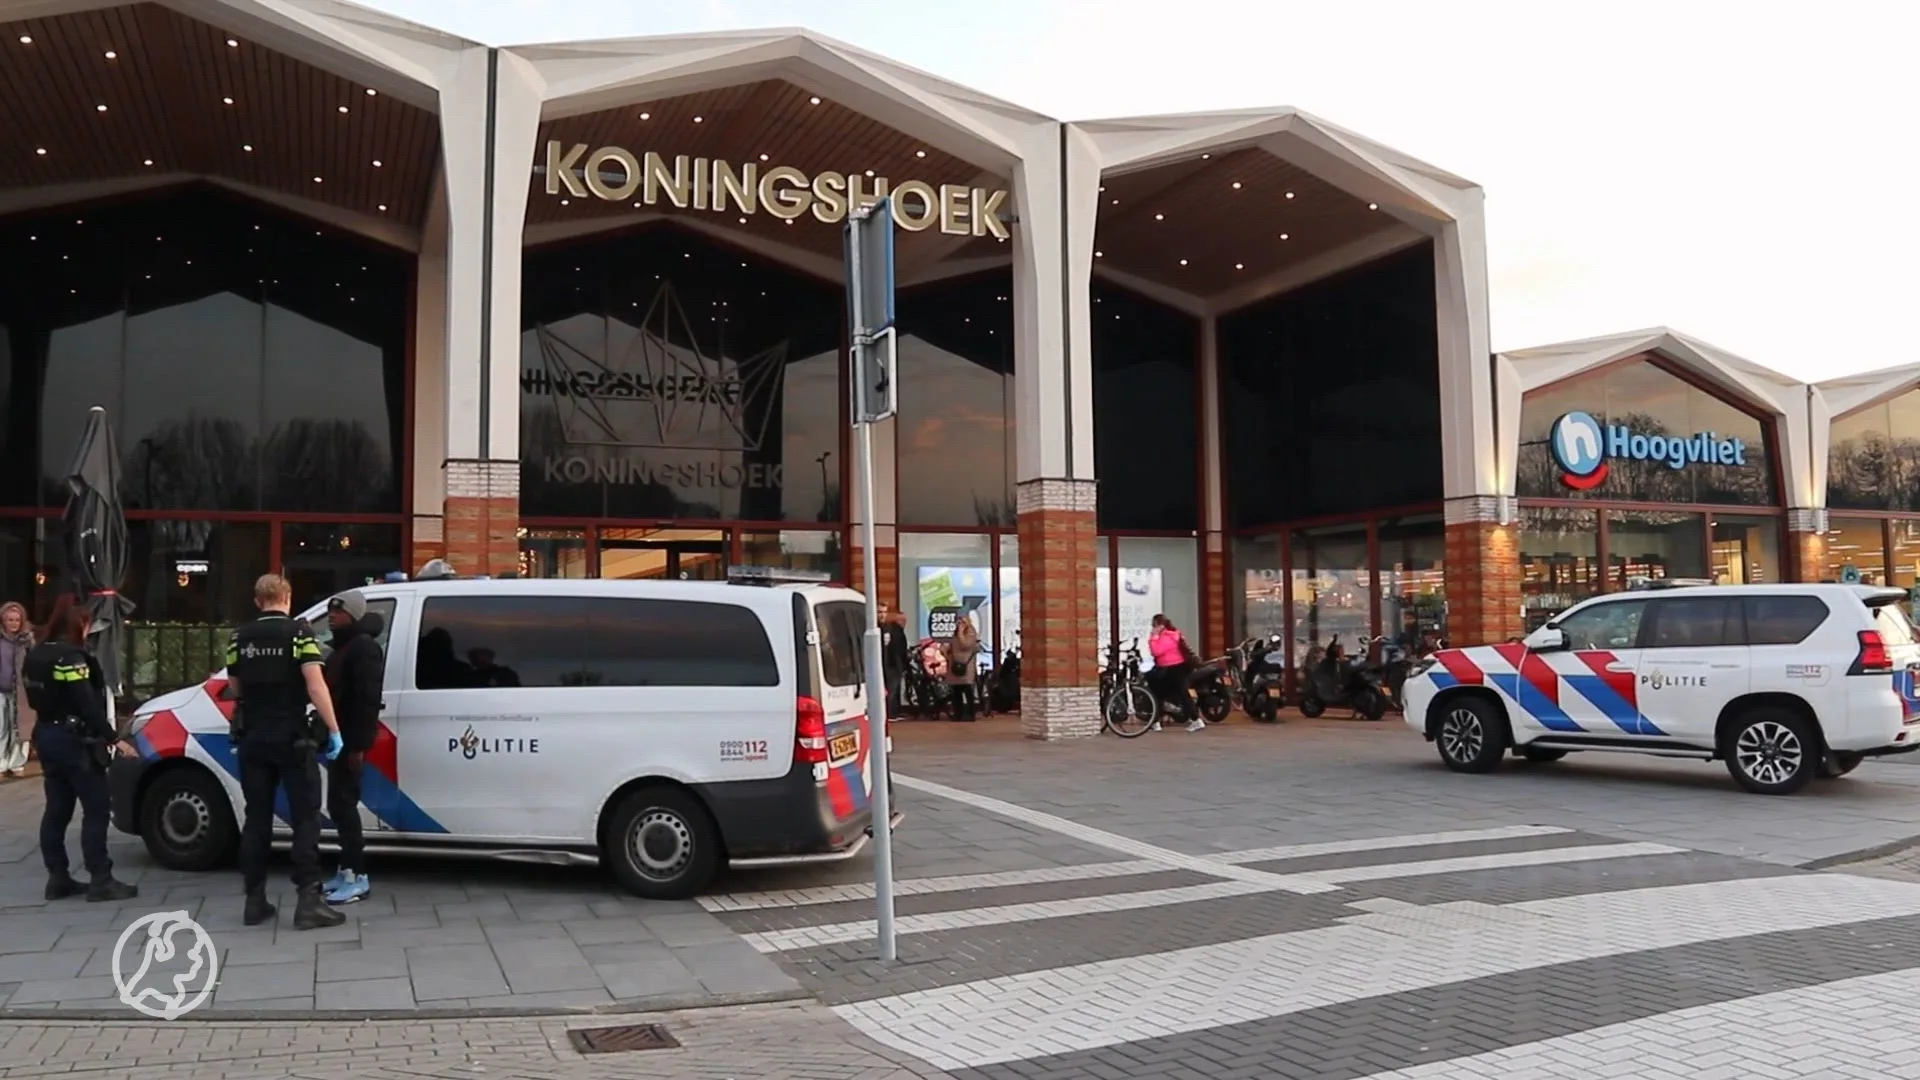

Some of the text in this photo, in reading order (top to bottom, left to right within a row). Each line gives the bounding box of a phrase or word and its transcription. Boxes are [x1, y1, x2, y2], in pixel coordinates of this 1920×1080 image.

[545, 140, 1010, 239] KONINGSHOEK
[1608, 424, 1746, 470] Hoogvliet
[545, 456, 785, 489] KONINGSHOEK
[931, 612, 956, 623] SPOT
[931, 622, 957, 632] GOED
[240, 647, 284, 658] POLITIE
[1641, 675, 1708, 690] POLITIE
[447, 737, 540, 760] POLITIE
[744, 740, 768, 753] 112
